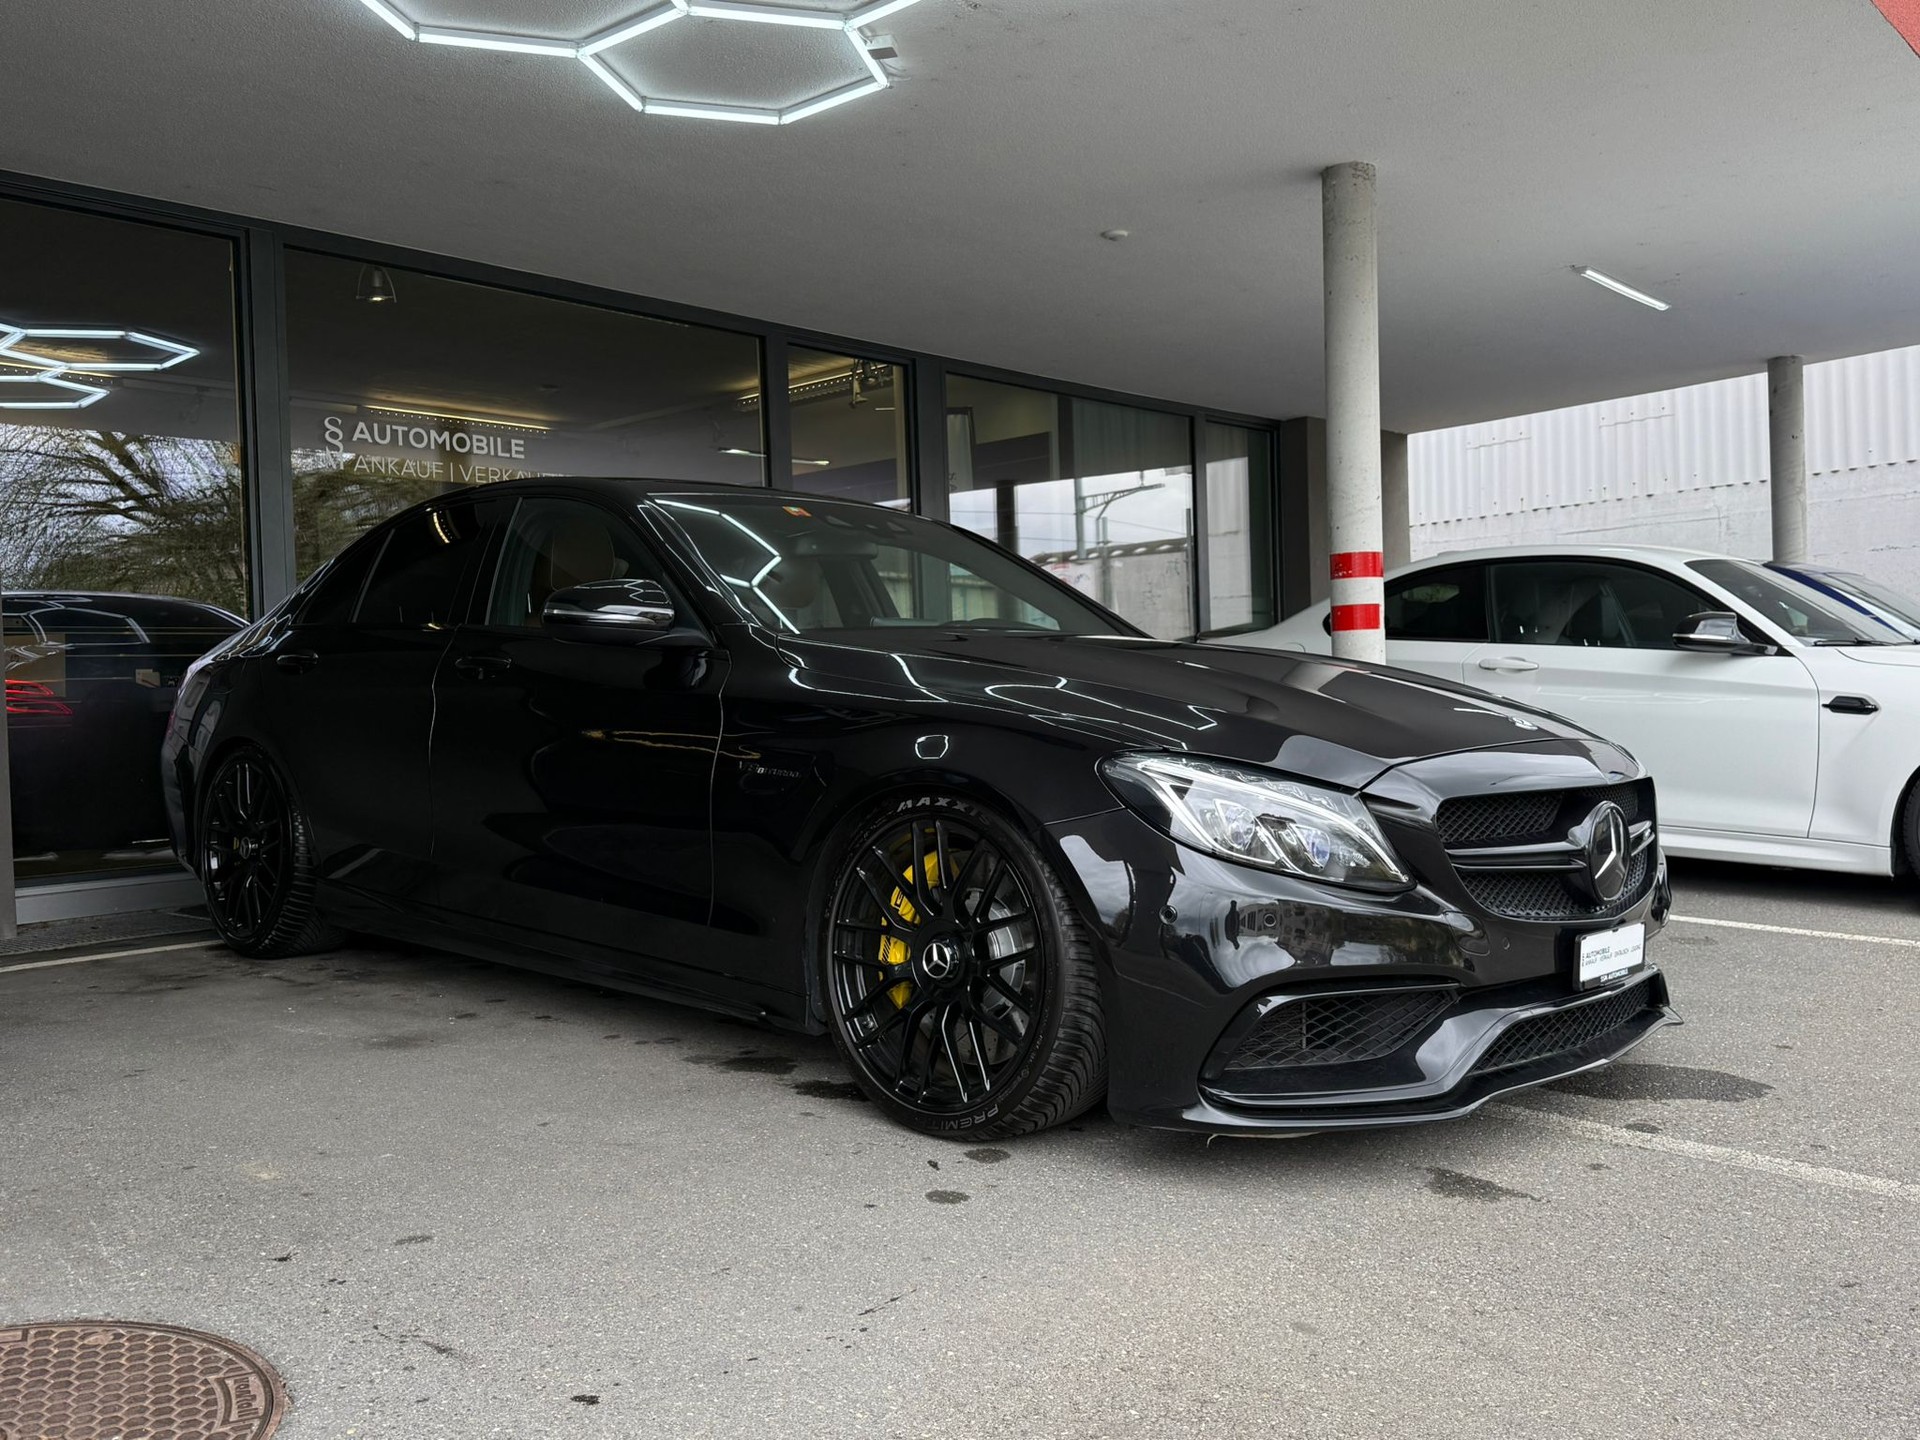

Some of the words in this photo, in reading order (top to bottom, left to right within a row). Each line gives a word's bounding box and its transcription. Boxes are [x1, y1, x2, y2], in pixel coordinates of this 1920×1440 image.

[352, 421, 525, 459] AUTOMOBILE
[353, 455, 444, 480] ANKAUF
[896, 796, 990, 826] MAXXIS
